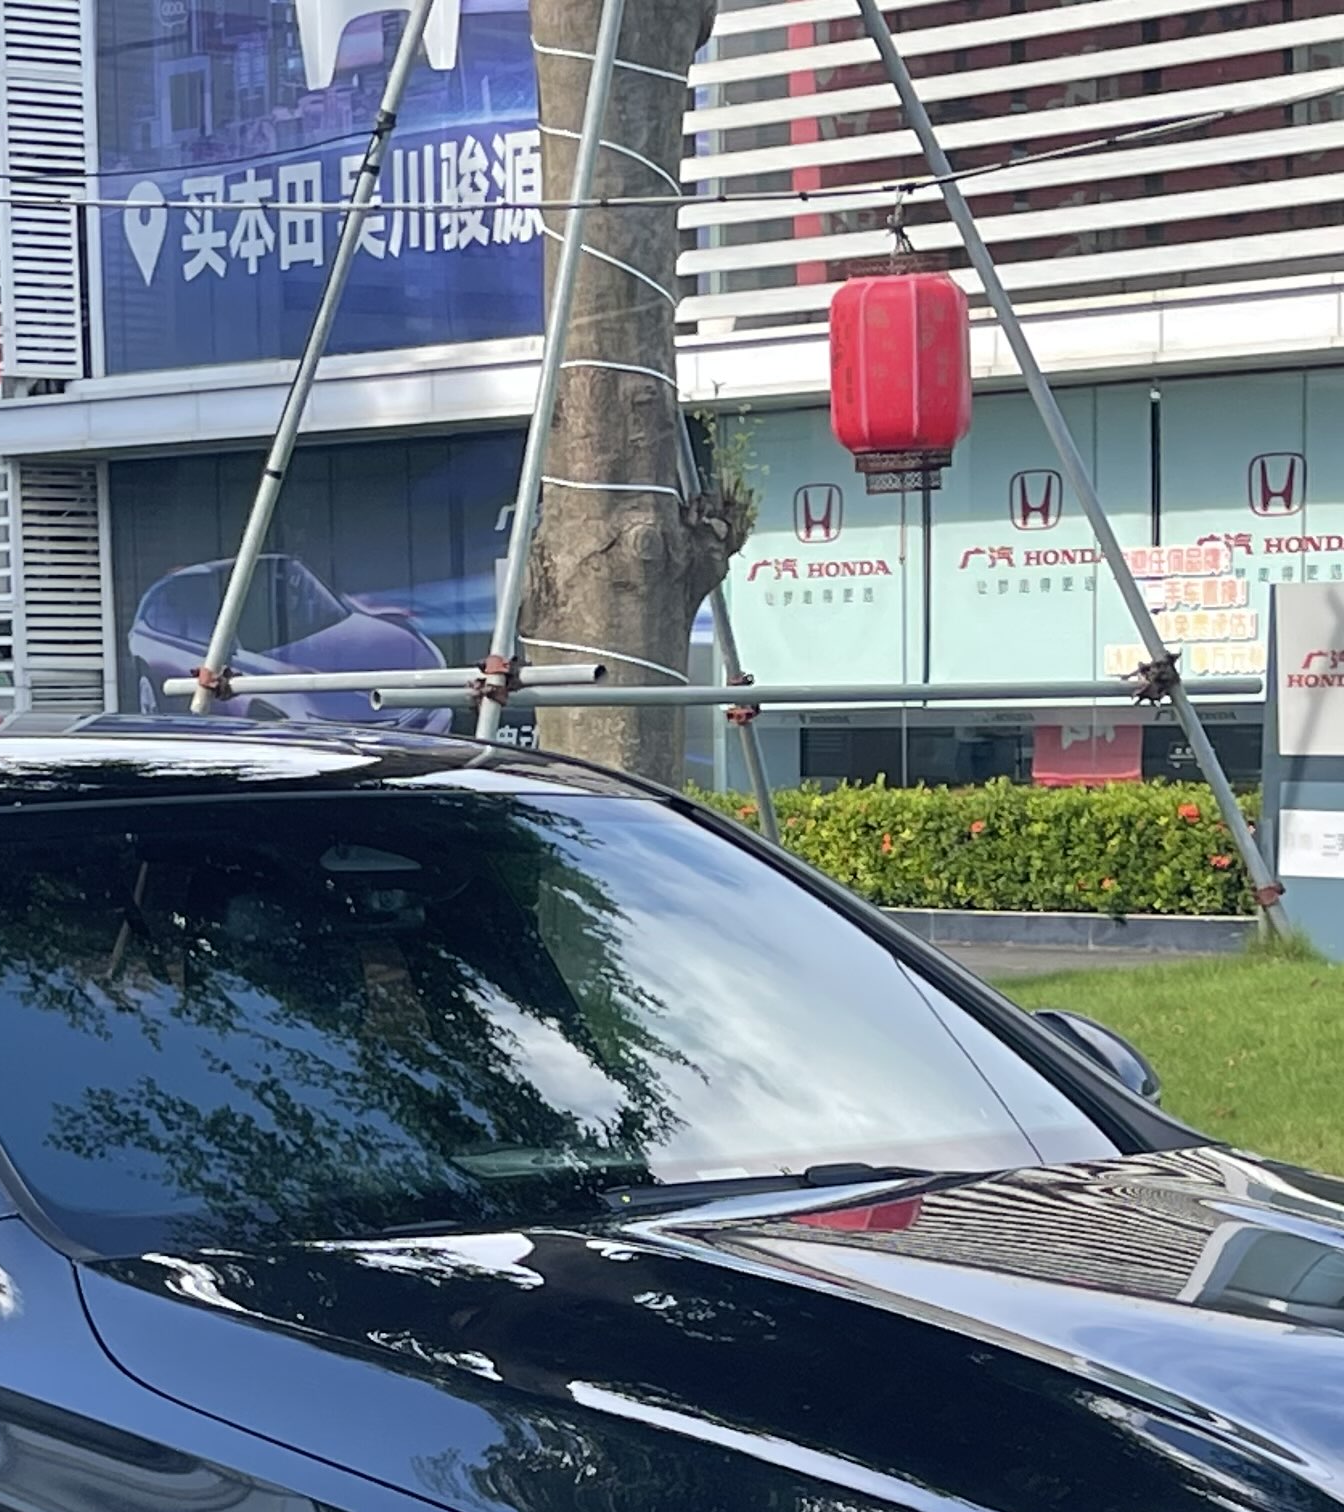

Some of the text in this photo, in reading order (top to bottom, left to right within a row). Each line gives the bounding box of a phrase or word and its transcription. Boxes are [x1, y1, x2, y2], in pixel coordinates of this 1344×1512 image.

[181, 160, 323, 282] 买本田
[808, 560, 892, 578] HONDA
